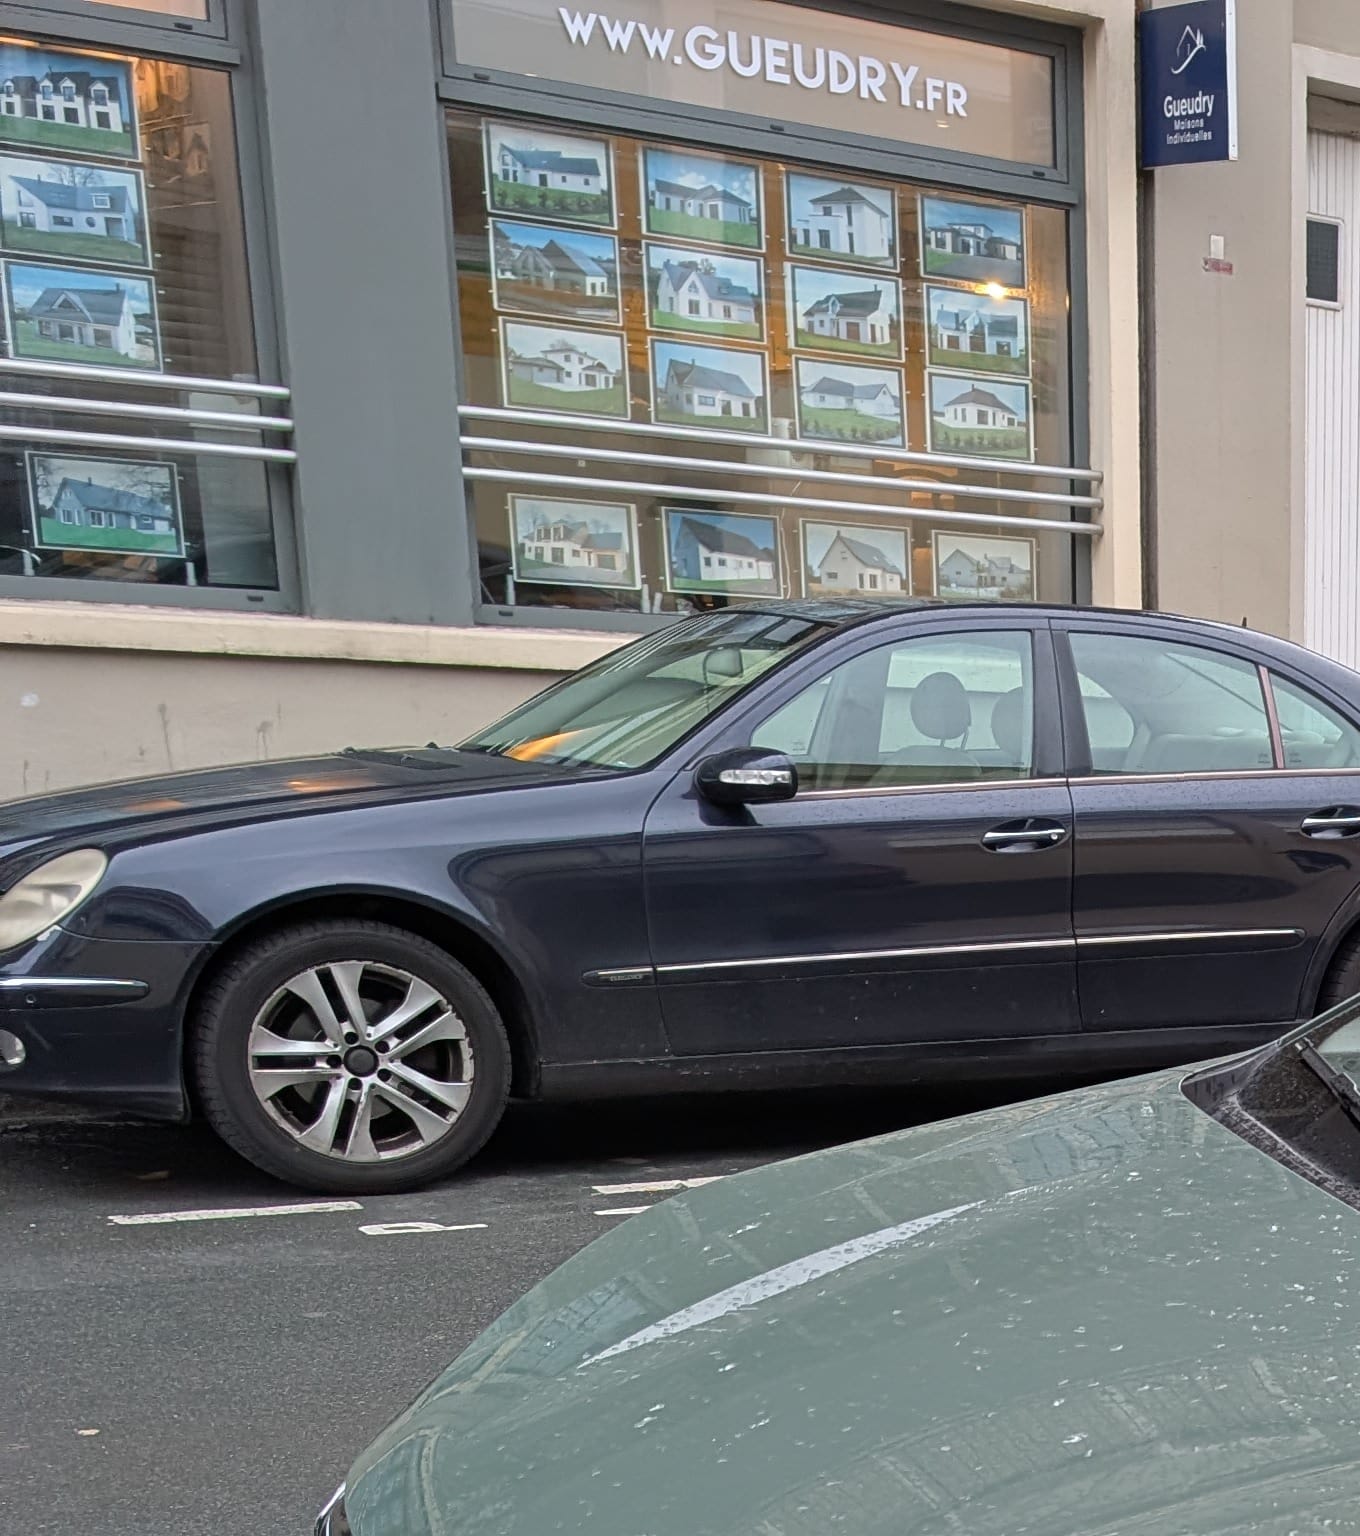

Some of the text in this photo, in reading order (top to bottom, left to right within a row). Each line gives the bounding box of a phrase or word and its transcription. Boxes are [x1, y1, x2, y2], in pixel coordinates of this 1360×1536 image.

[558, 7, 968, 118] www.GUEUDRY.FR
[1163, 91, 1215, 118] Gueudry
[1173, 118, 1205, 131] Maisons
[1166, 131, 1213, 145] Individuelles
